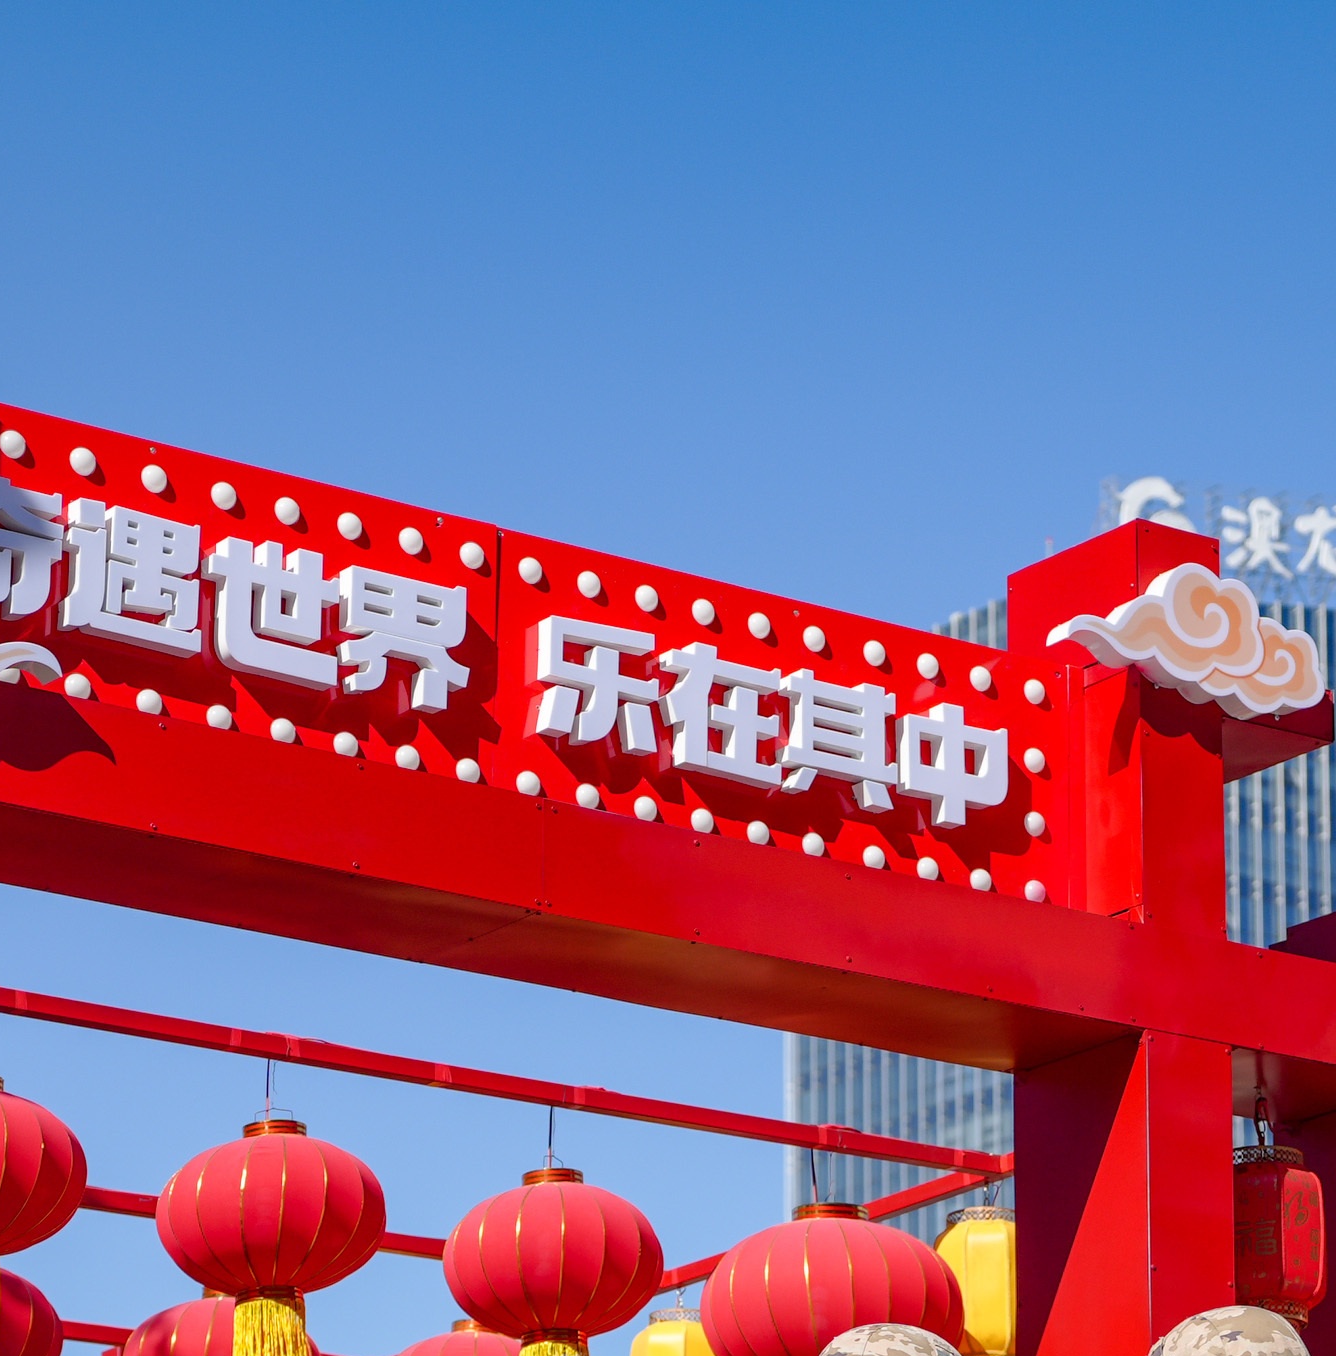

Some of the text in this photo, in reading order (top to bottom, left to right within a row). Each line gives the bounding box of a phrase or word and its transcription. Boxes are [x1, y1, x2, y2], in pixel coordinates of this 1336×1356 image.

[534, 613, 1009, 831] 乐在其中
[1235, 1218, 1277, 1256] 福
